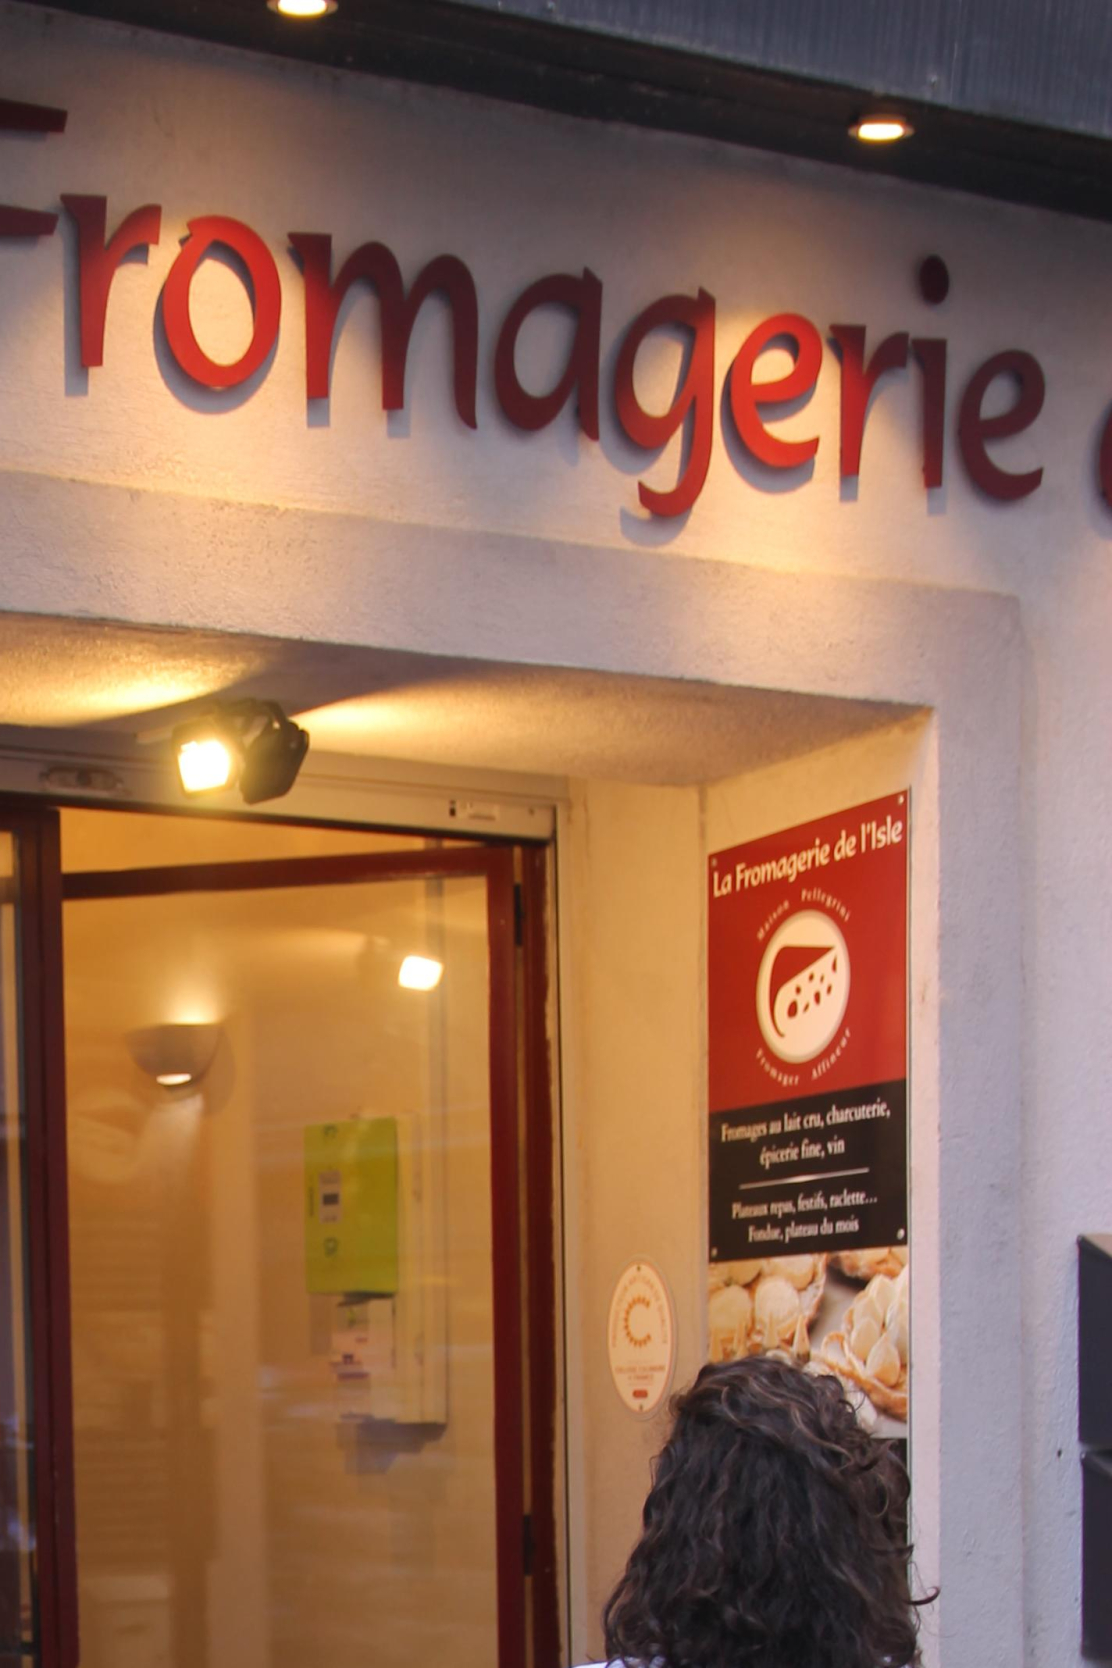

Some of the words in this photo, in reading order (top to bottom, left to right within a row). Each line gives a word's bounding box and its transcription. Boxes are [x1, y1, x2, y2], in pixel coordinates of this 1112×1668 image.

[713, 871, 732, 898] La
[735, 837, 831, 883] Fromagerie
[833, 829, 857, 862] de
[860, 815, 904, 853] l'Isle
[801, 886, 851, 923] Pellegrini
[756, 1047, 799, 1088] Fromager
[811, 1026, 851, 1081] Affineur
[721, 1120, 768, 1143] Fromages
[769, 1119, 782, 1135] au
[783, 1112, 801, 1133] lait
[802, 1112, 825, 1130] cru,
[826, 1097, 891, 1126] charcuterie,
[759, 1140, 799, 1170] épicerie
[800, 1137, 825, 1160] fine,
[827, 1134, 846, 1155] vin
[731, 1201, 768, 1220] Plateaux
[769, 1199, 797, 1219] repas,
[796, 1189, 828, 1214] festifs,
[748, 1222, 784, 1243] Fondue,
[785, 1220, 819, 1244] plateau
[819, 1216, 835, 1236] du
[835, 1214, 860, 1234] mois
